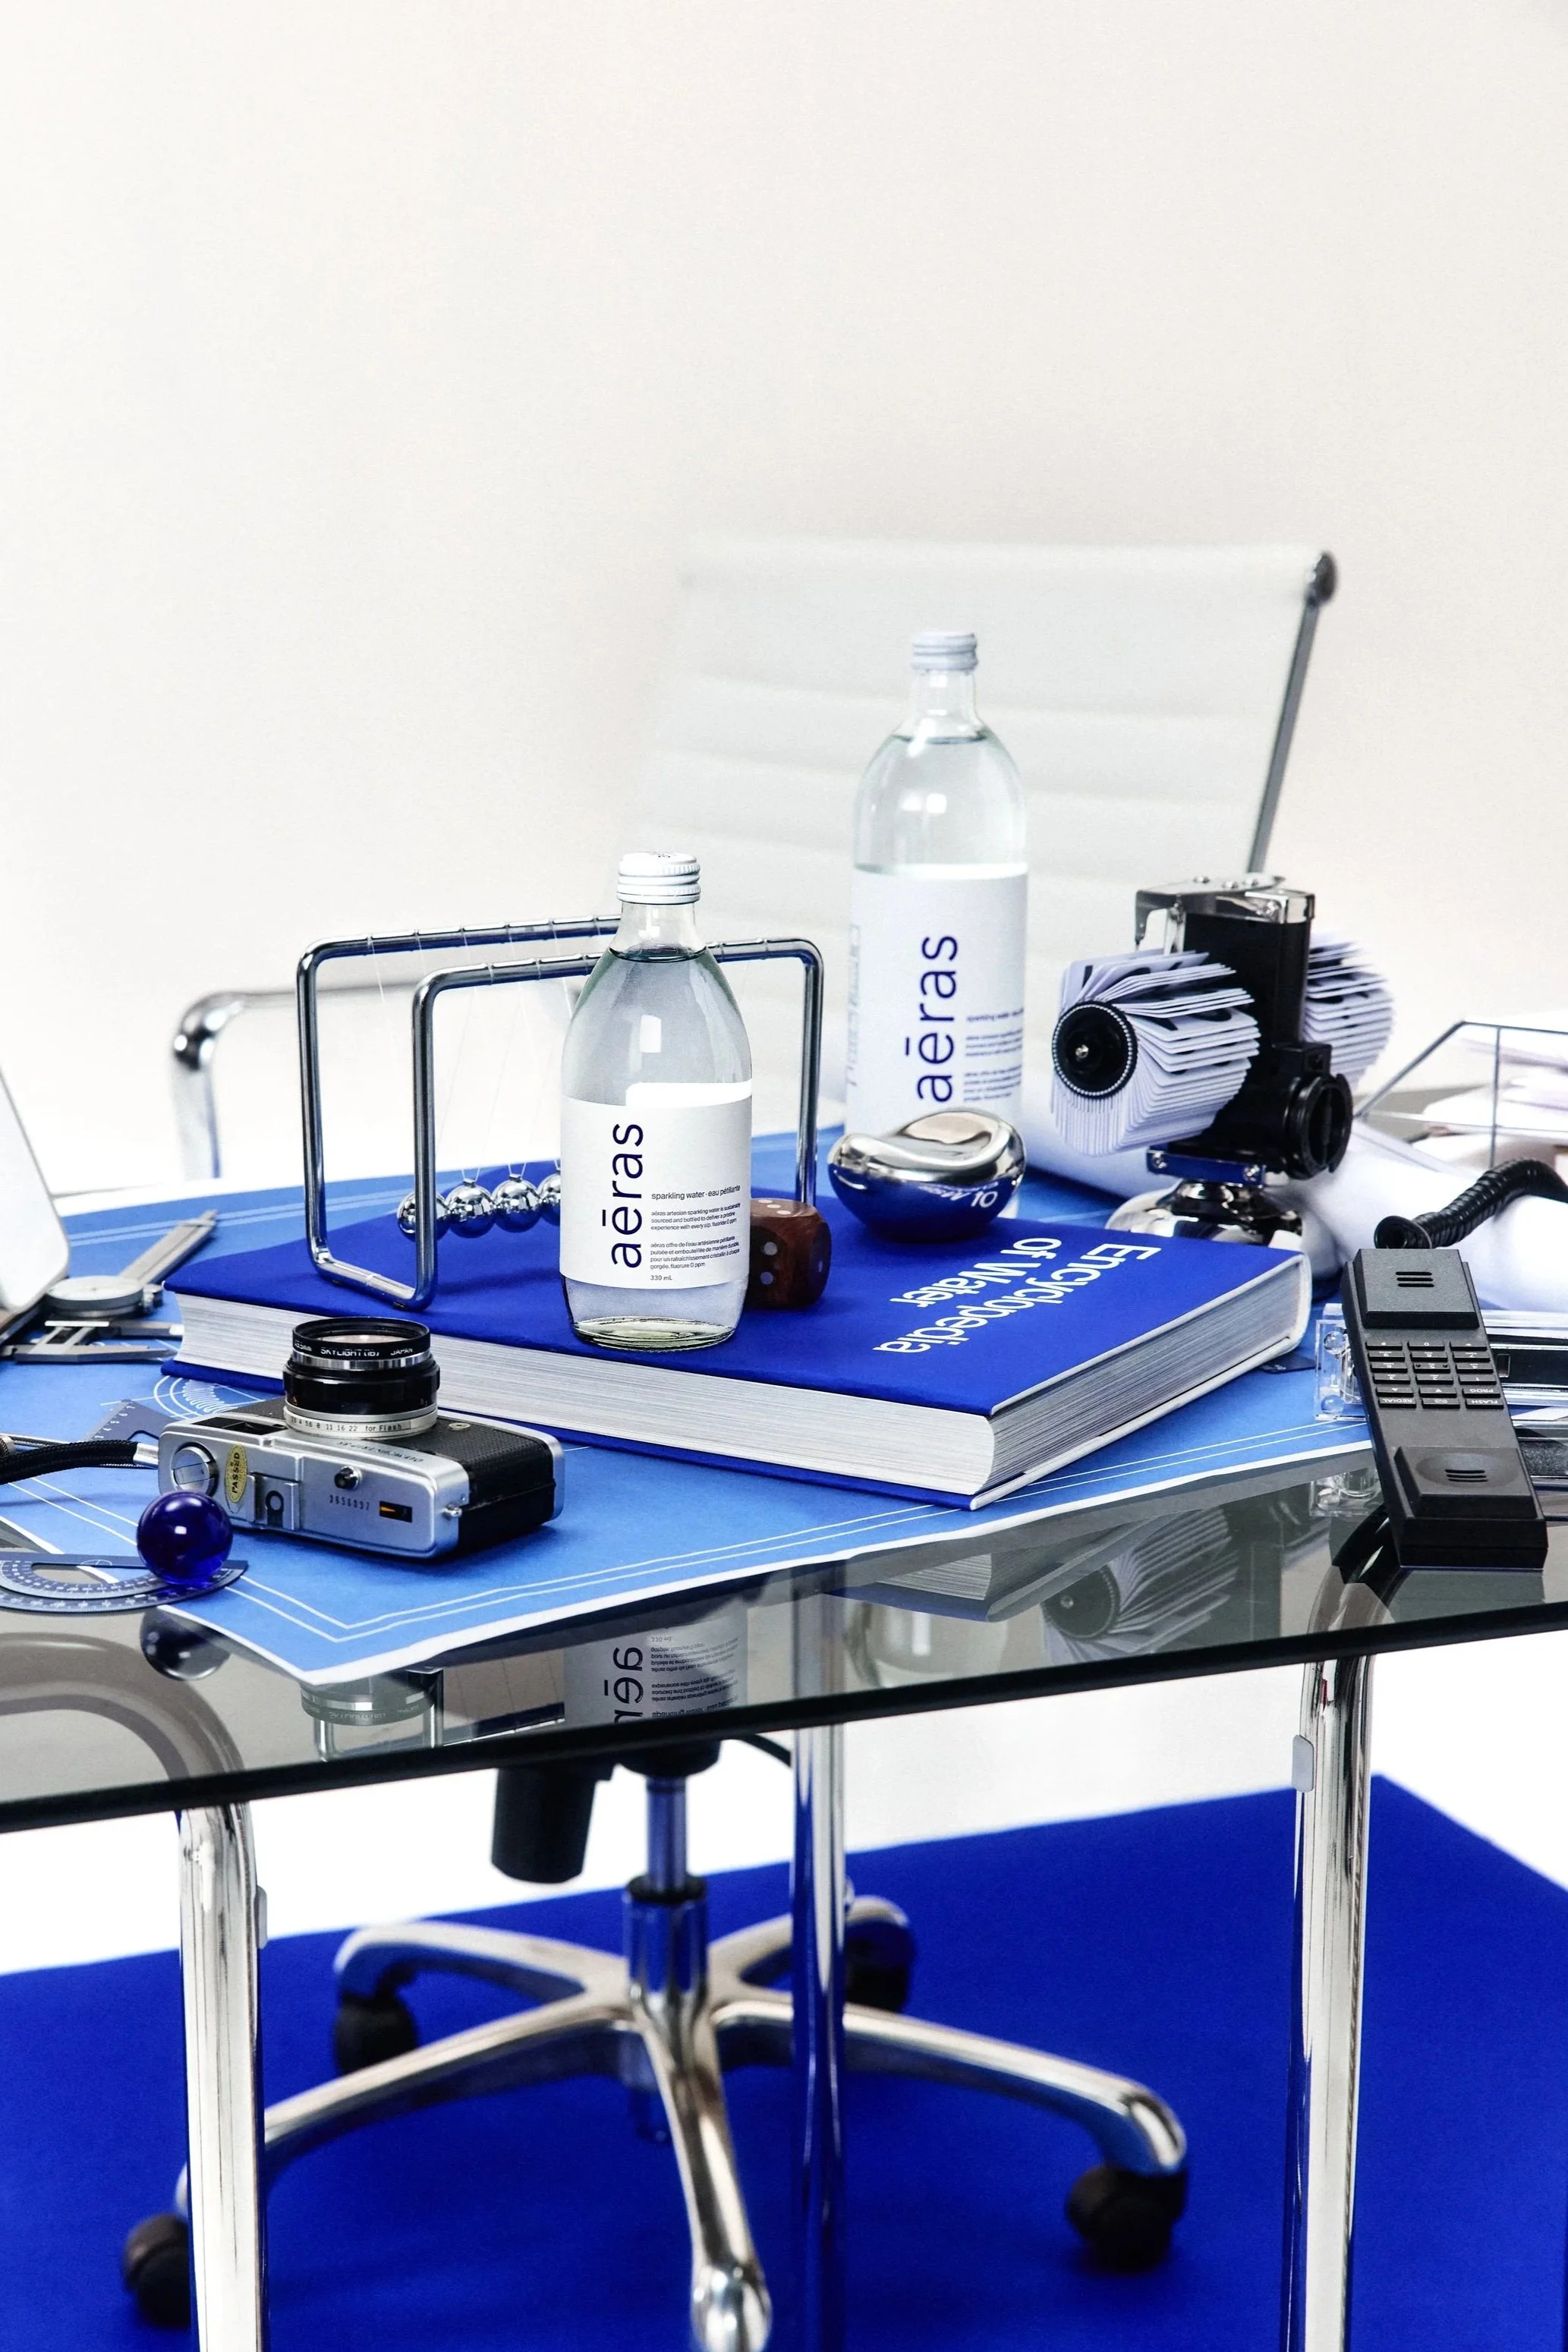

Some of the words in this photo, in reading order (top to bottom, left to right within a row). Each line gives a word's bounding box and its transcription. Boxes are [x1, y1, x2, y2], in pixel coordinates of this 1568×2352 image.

[1000, 1238, 1063, 1260] of
[873, 1243, 1161, 1353] Encyclopedia
[890, 1263, 1041, 1308] Water
[231, 1452, 240, 1494] PASSED
